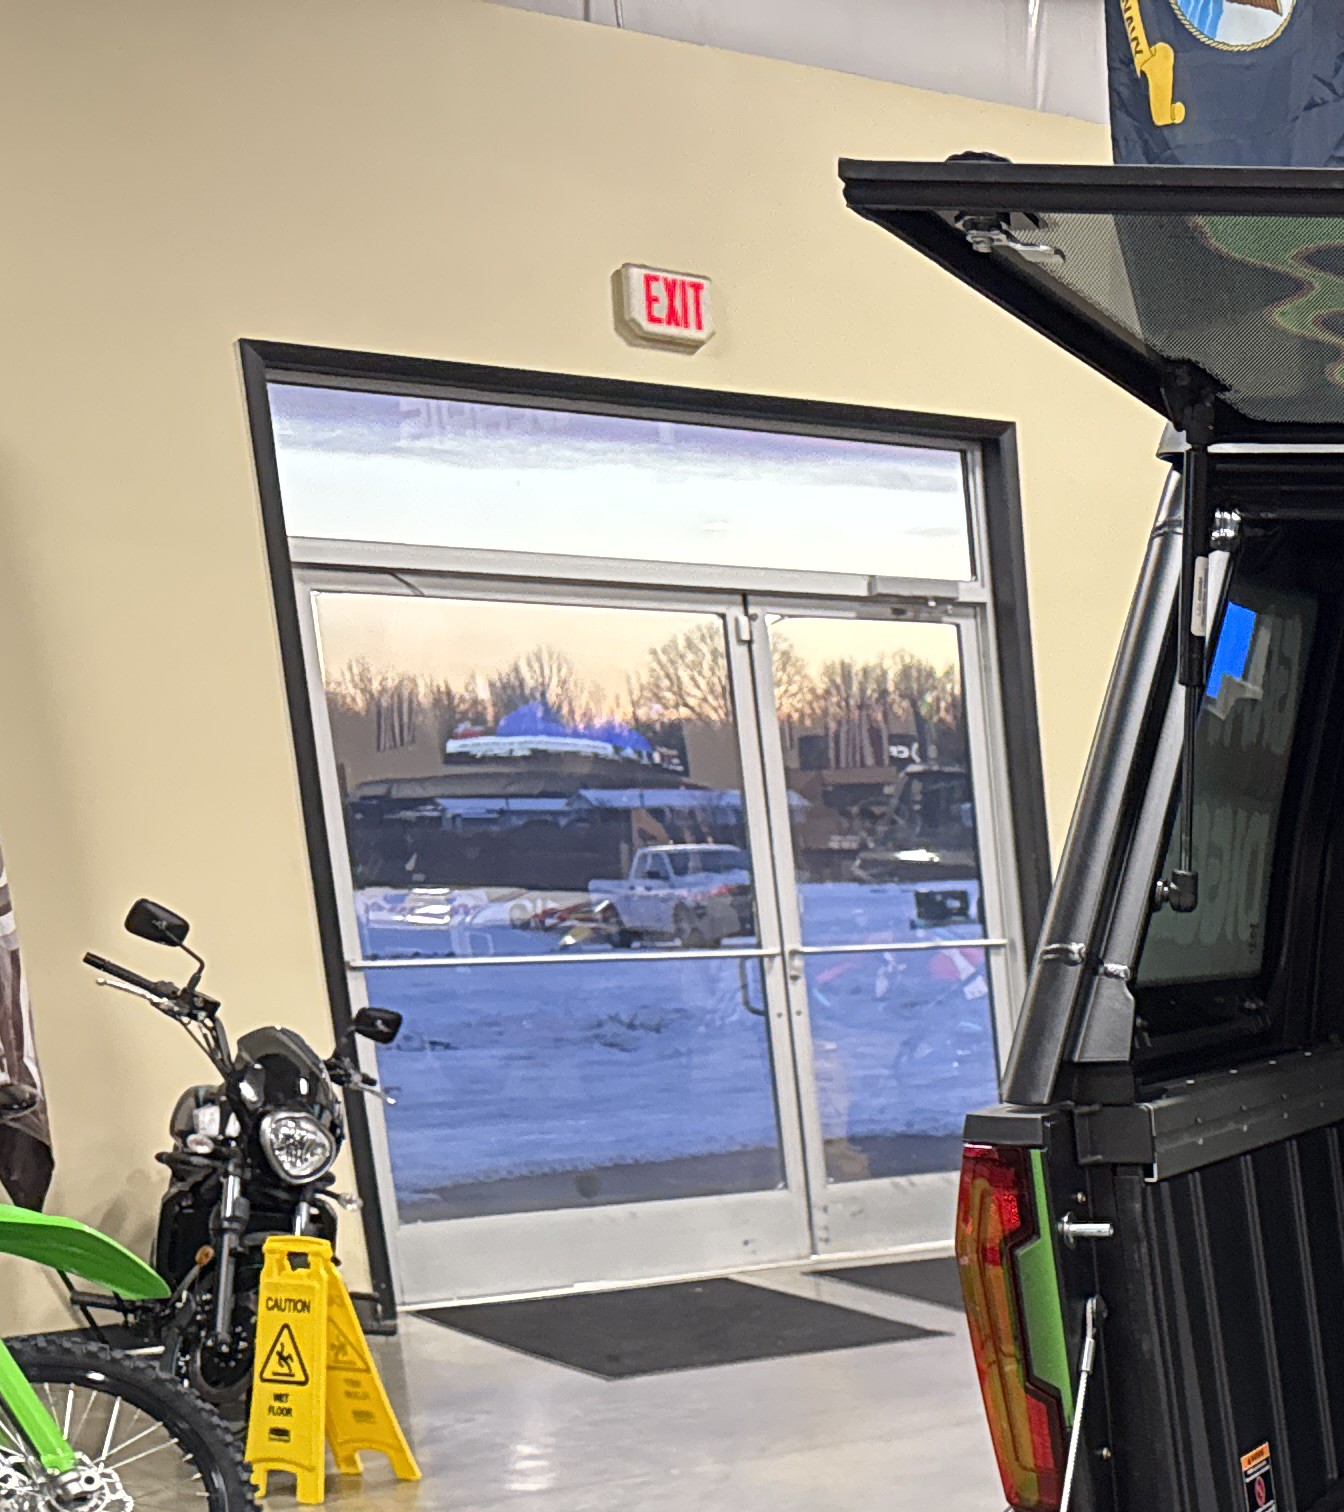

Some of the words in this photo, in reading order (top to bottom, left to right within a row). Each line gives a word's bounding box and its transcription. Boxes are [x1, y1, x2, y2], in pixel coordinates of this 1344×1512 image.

[643, 273, 704, 331] EXIT
[266, 1296, 311, 1314] CAUTION
[267, 1405, 293, 1417] FLOOR
